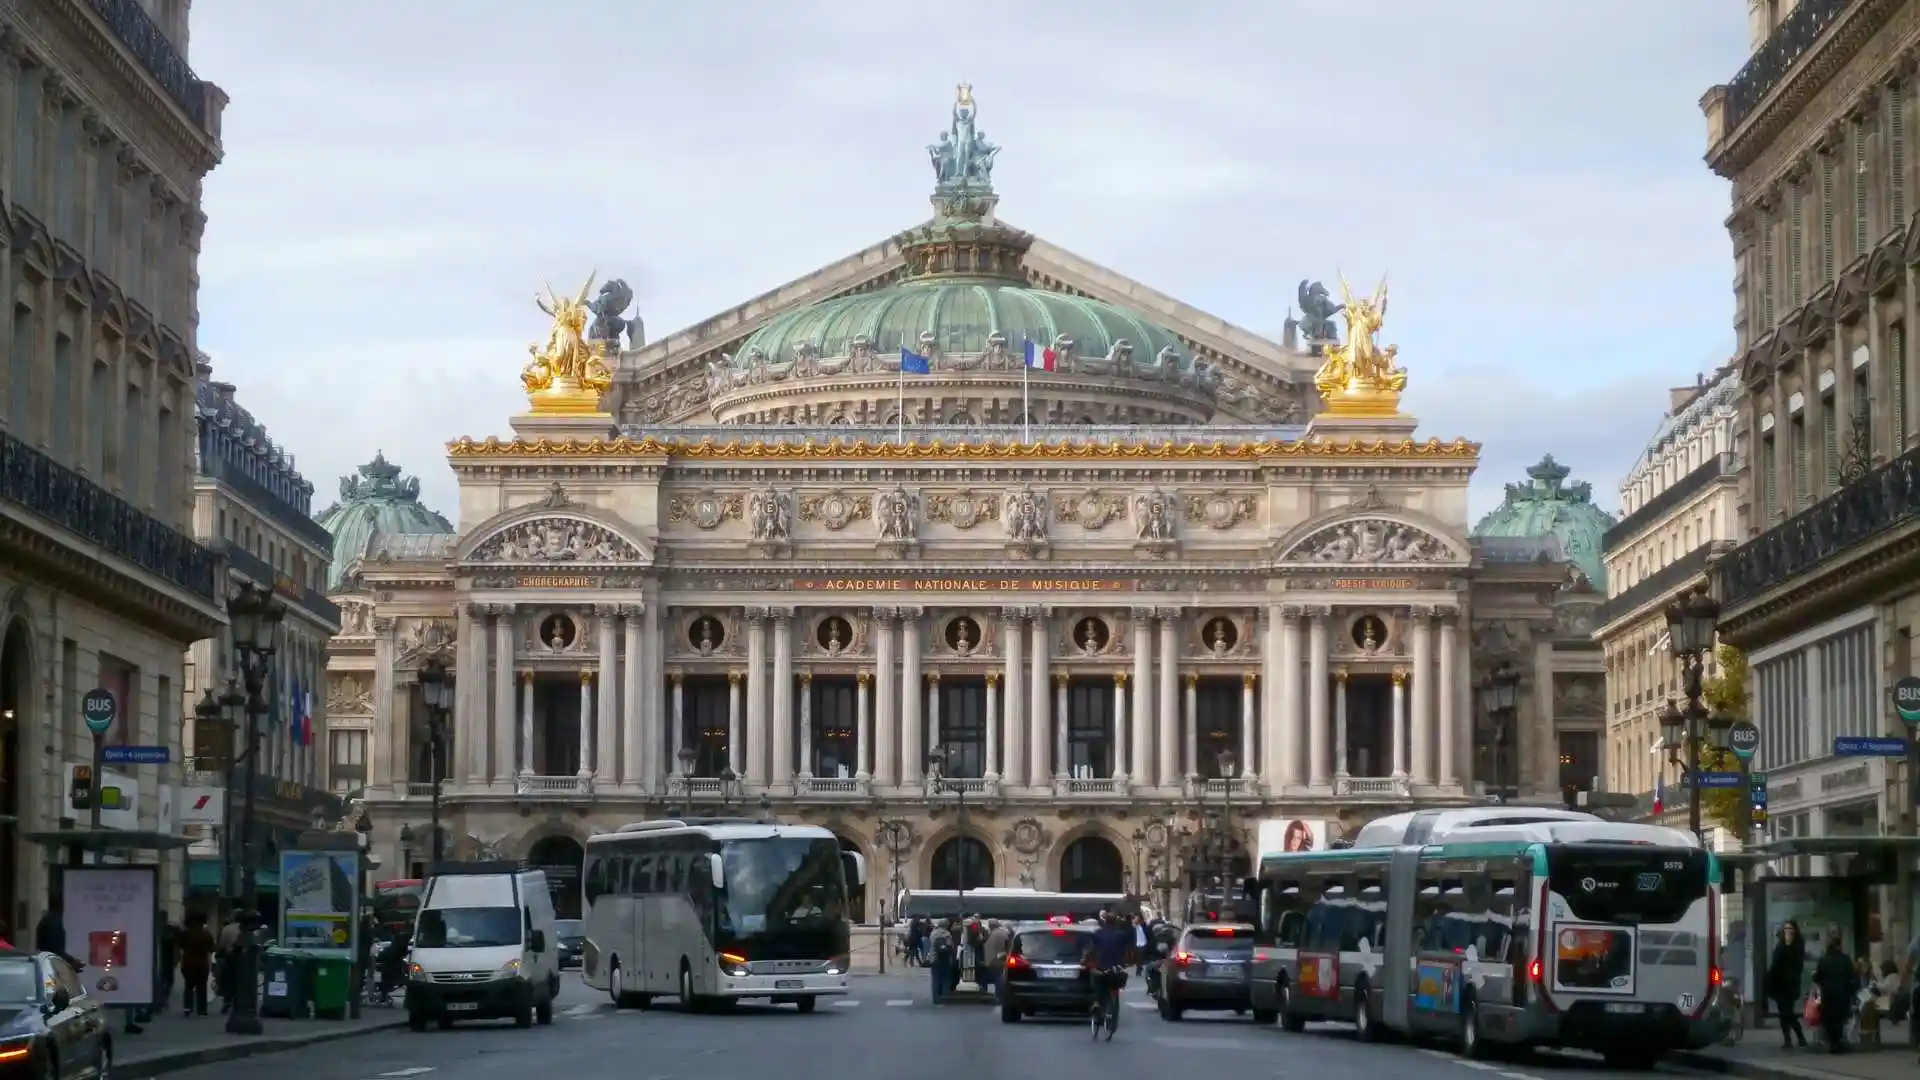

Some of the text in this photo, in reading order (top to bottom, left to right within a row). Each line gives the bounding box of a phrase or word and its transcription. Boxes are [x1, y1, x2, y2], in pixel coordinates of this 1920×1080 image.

[826, 580, 1101, 590] ACADEMIE NATIONALE DE MUSIQUE
[87, 699, 111, 711] BUS
[1733, 730, 1756, 742] BUS
[1681, 994, 1693, 1008] 70
